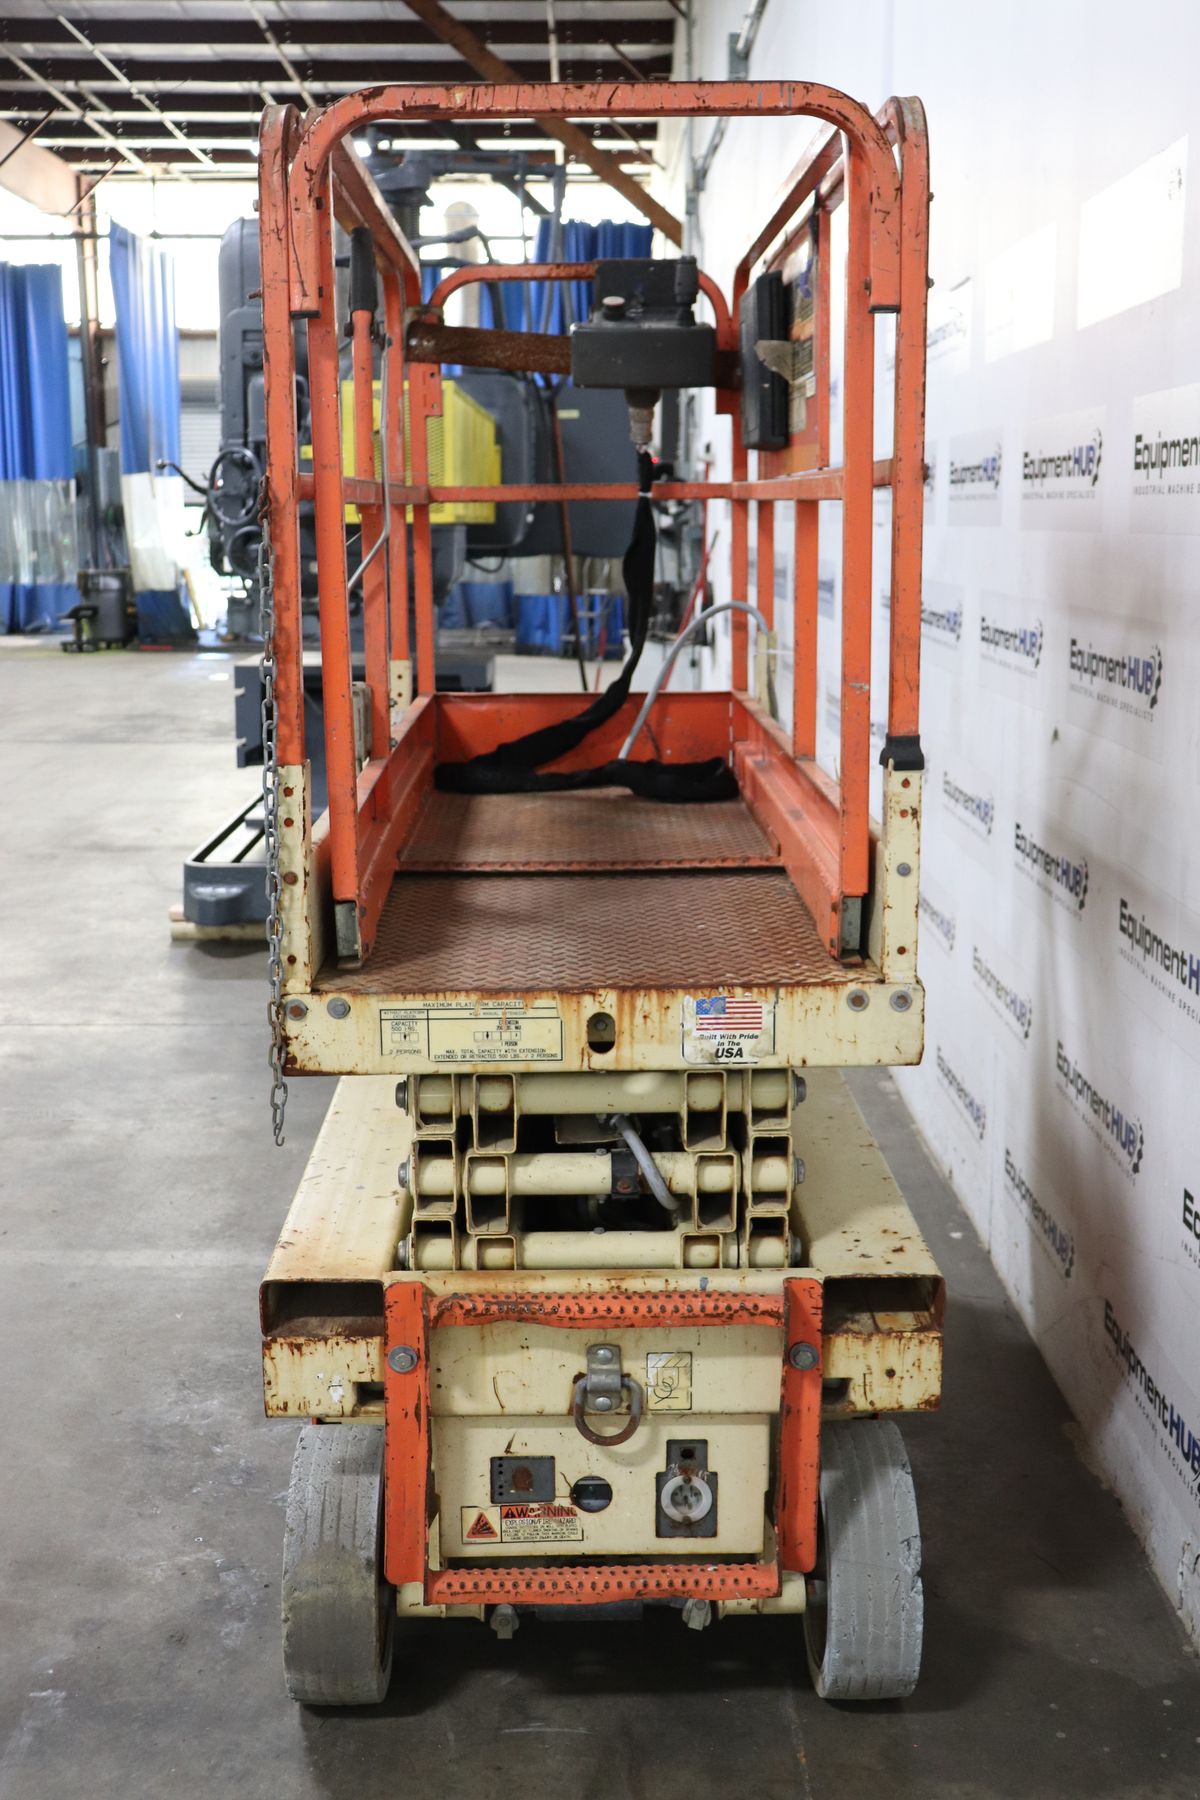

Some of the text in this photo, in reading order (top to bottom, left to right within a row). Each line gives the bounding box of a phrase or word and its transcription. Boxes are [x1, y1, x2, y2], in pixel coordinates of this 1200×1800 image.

[1022, 444, 1097, 487] EquipmentHUB
[1134, 430, 1200, 480] Equipmen
[980, 616, 1038, 659] EquipmentHUB
[1069, 638, 1154, 696] EquipmentHUB
[1014, 822, 1083, 899] EquipmentHUB
[492, 1000, 526, 1008] CAPACIT
[972, 945, 1028, 1027] EquipmentHUB
[714, 1047, 743, 1058] USA
[1055, 1039, 1138, 1159] EquipmentHUB
[1004, 1148, 1071, 1266] EquipmentHUB
[1104, 1299, 1200, 1475] EquipmentHUB
[515, 1506, 577, 1518] WARNING
